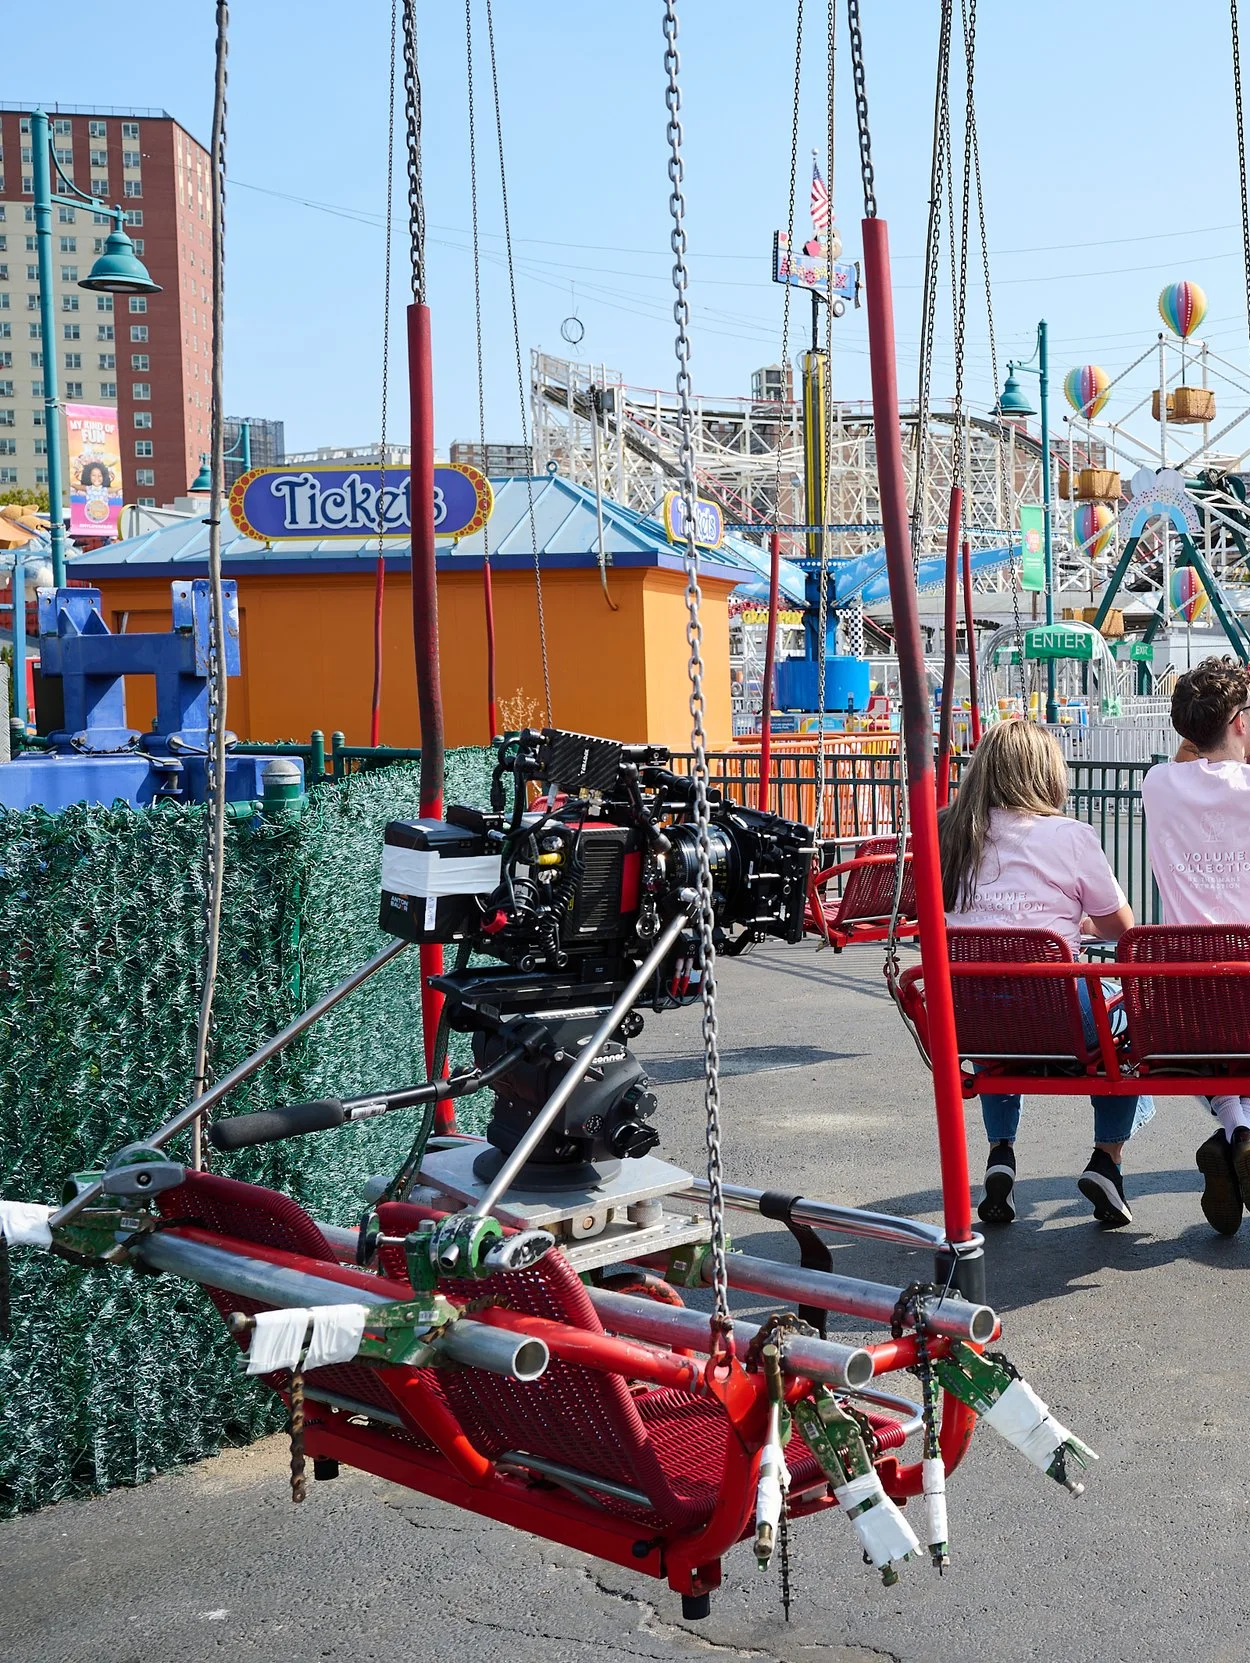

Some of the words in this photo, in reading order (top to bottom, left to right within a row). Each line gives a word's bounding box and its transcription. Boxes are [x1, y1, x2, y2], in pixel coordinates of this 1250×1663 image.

[70, 420, 81, 430] MY
[83, 421, 104, 434] KIND
[104, 424, 115, 434] OF
[81, 429, 106, 444] FUN
[1032, 632, 1087, 649] ENTER
[1135, 645, 1149, 655] EXIT
[1183, 851, 1246, 862] VOLUME
